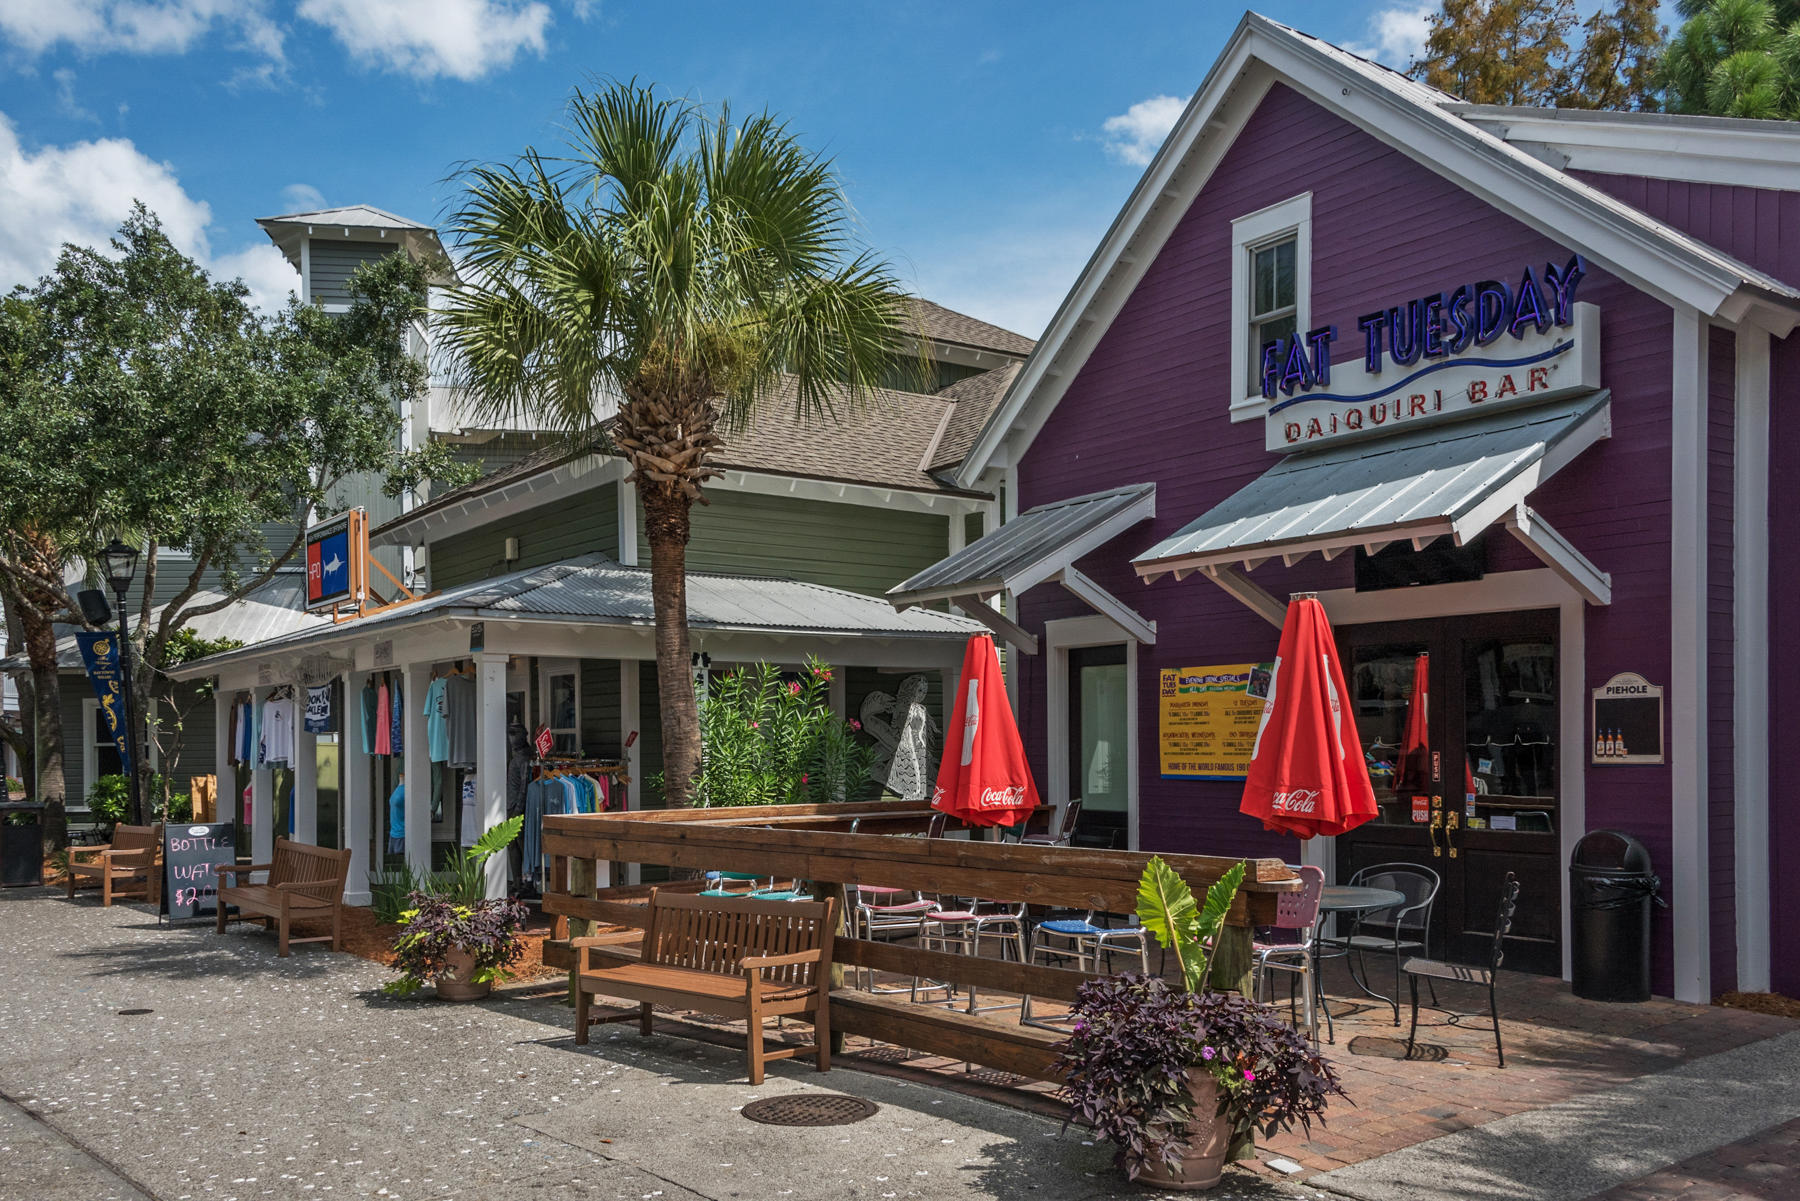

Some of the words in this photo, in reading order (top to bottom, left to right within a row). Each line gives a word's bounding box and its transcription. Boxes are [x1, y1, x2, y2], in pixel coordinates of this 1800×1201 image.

[1262, 325, 1338, 399] FAT
[1357, 253, 1587, 375] TUESDAY
[1284, 389, 1442, 443] DAIQUIRI
[1467, 367, 1549, 404] BAR
[1162, 673, 1176, 681] FAT
[1606, 686, 1648, 695] PIEHOLE
[540, 734, 551, 754] Sale
[1168, 762, 1181, 770] HOME
[1182, 762, 1187, 770] OF
[1198, 763, 1214, 771] WORLD
[1215, 763, 1234, 771] FAMOUS
[981, 786, 1026, 807] Coca-Cola
[1412, 809, 1429, 822] PUSH
[170, 837, 229, 852] BOTTLE
[175, 885, 219, 906] $2.0
